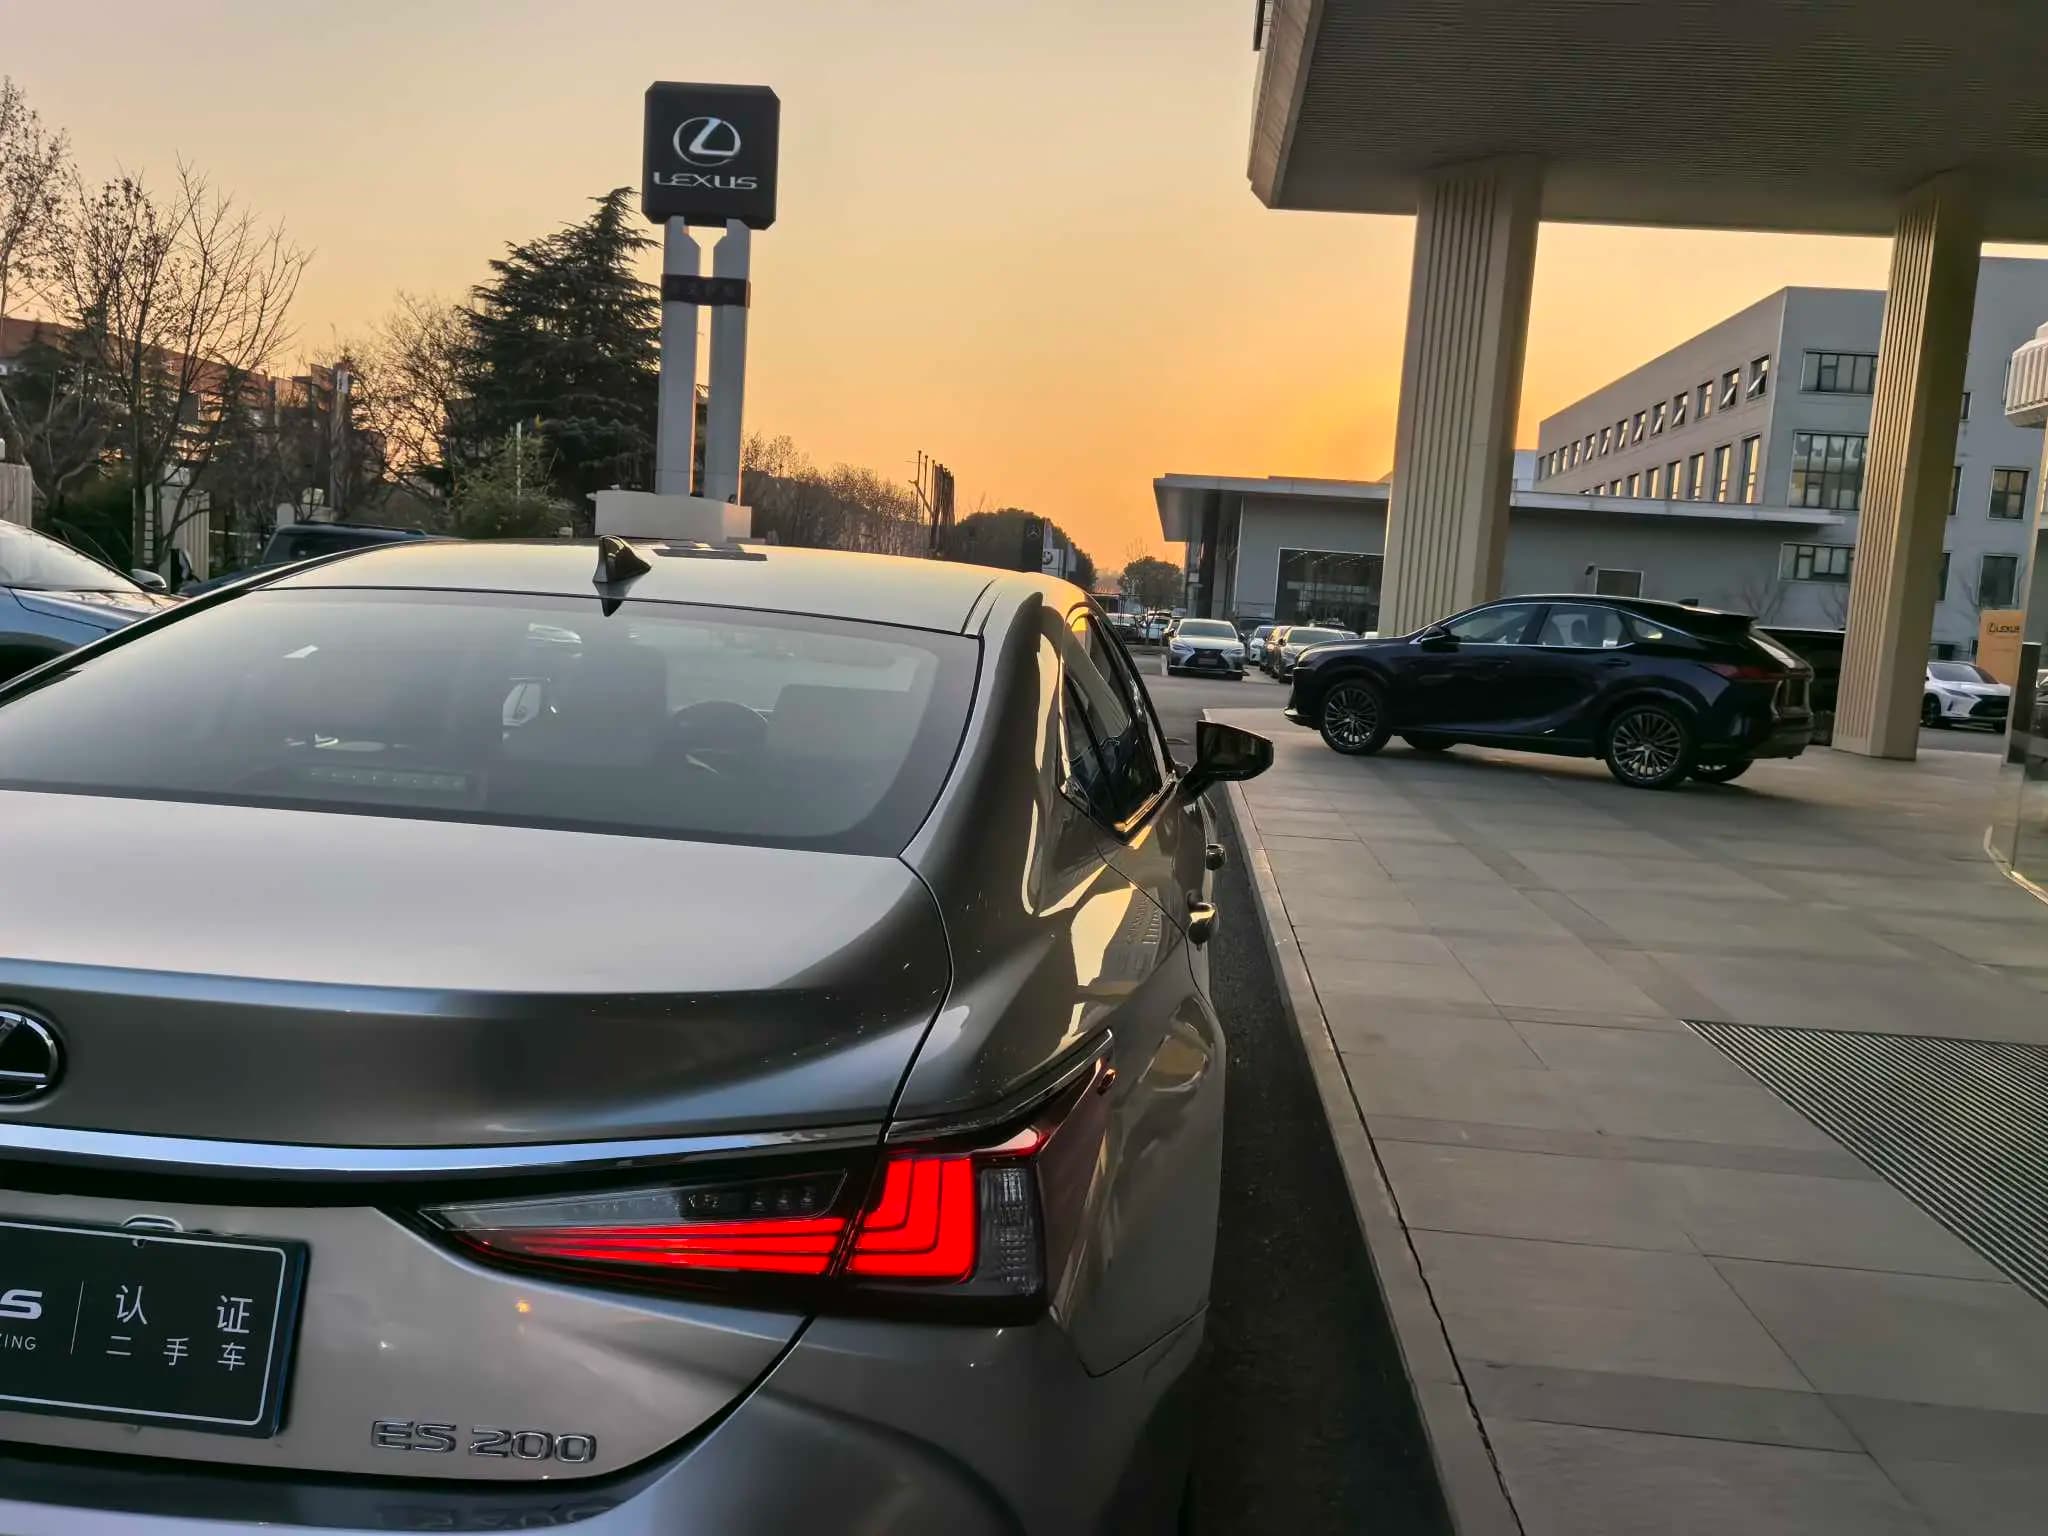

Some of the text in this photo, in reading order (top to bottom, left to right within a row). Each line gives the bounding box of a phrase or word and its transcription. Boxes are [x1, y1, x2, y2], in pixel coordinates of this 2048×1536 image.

[653, 171, 758, 190] LEXUS
[115, 1285, 254, 1334] 认证
[0, 1333, 37, 1351] ING
[106, 1335, 247, 1372] 二手车
[372, 1420, 598, 1464] ES 200
